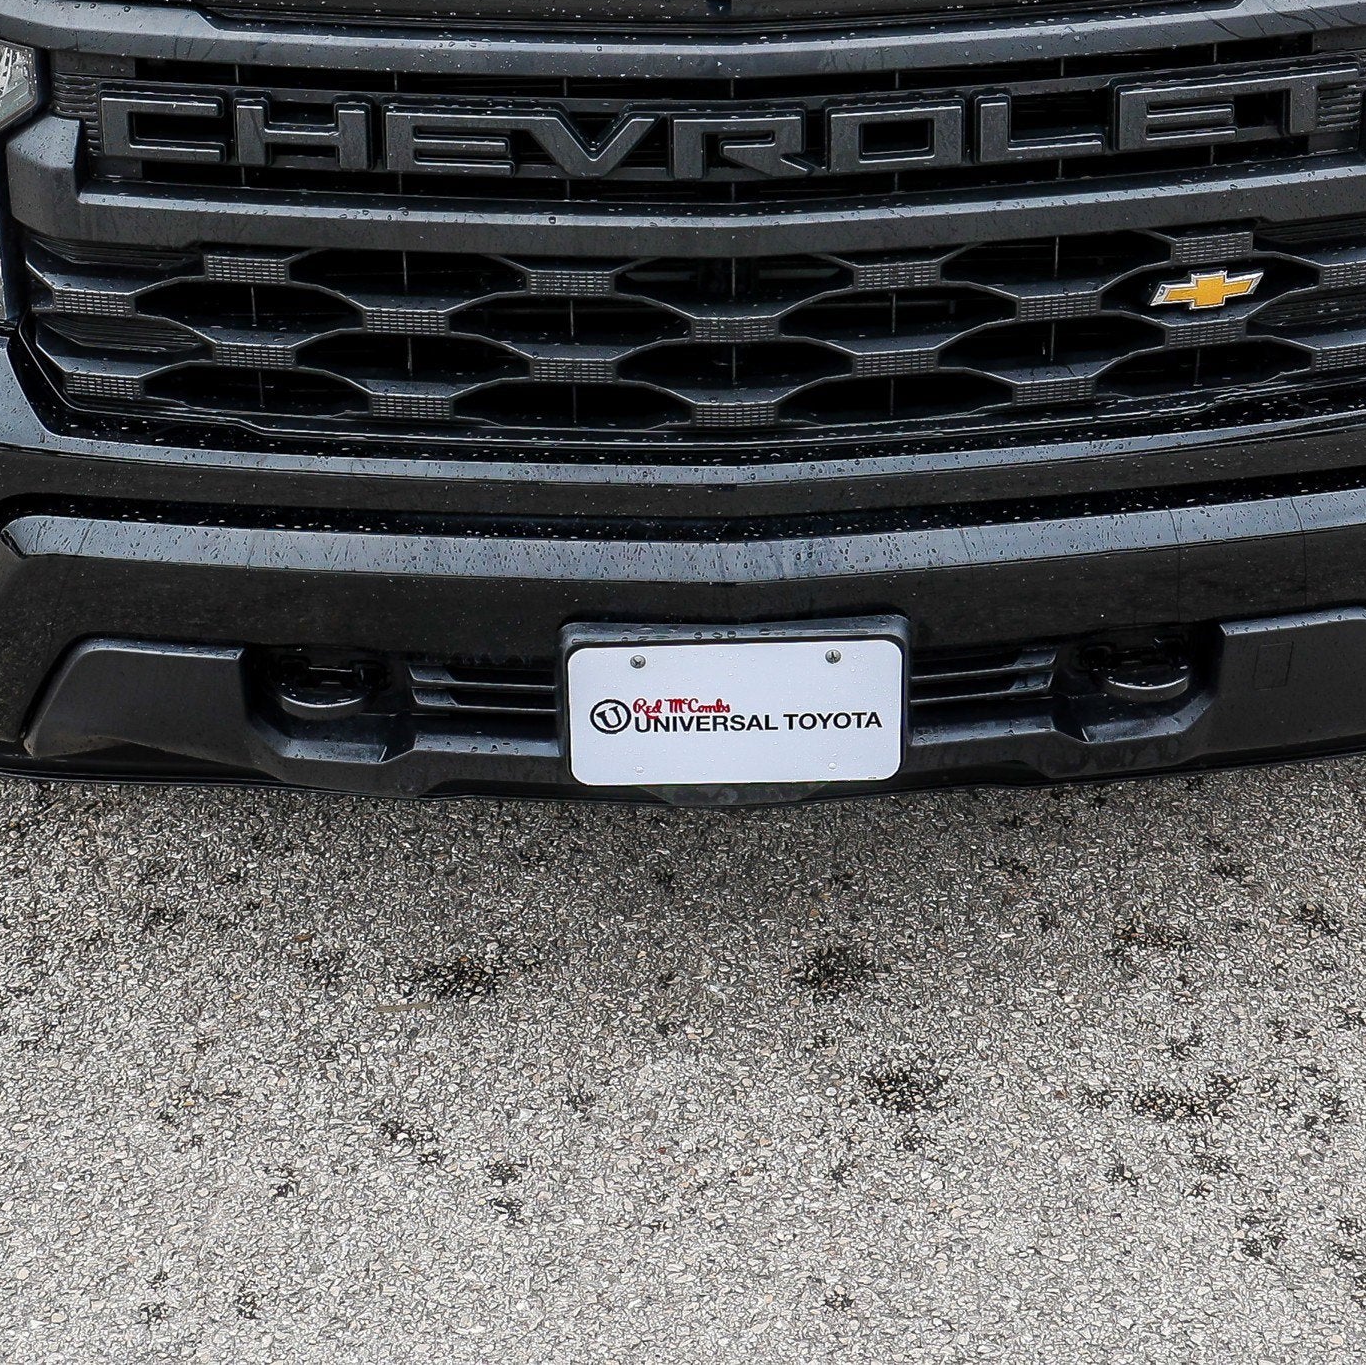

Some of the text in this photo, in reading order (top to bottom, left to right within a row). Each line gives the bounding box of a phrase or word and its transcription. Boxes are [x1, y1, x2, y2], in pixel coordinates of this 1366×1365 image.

[99, 65, 1360, 181] CHEVROLET
[633, 697, 731, 719] Red McCombs
[634, 711, 883, 733] UNIVERSAL TOYOTA
